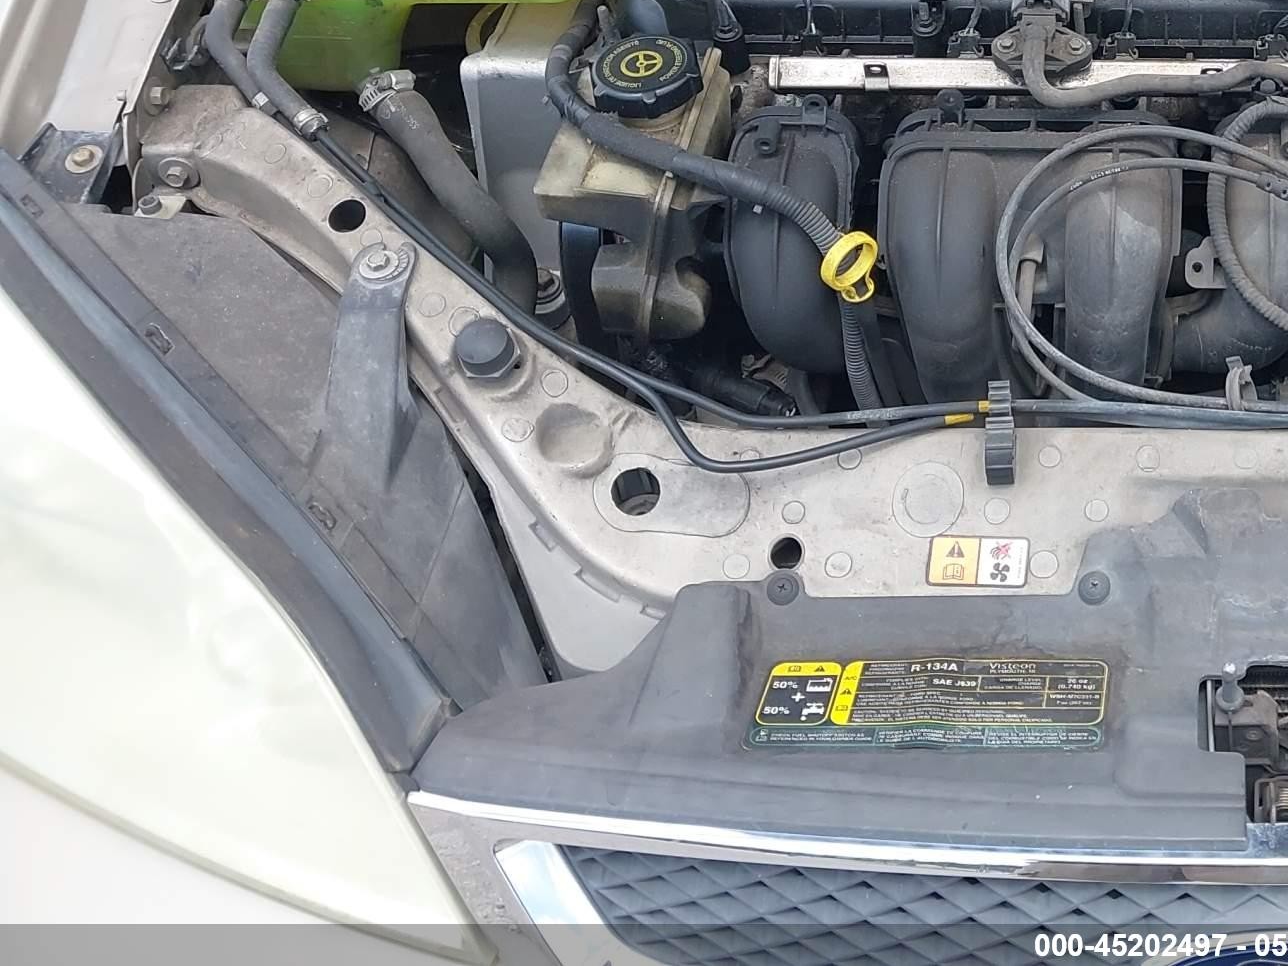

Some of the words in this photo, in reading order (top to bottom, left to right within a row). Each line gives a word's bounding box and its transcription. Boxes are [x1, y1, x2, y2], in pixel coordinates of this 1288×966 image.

[910, 662, 958, 673] R-134A
[989, 662, 1037, 670] Visteon
[772, 680, 799, 689] 50%
[932, 678, 953, 686] SAE
[762, 705, 791, 715] 50%
